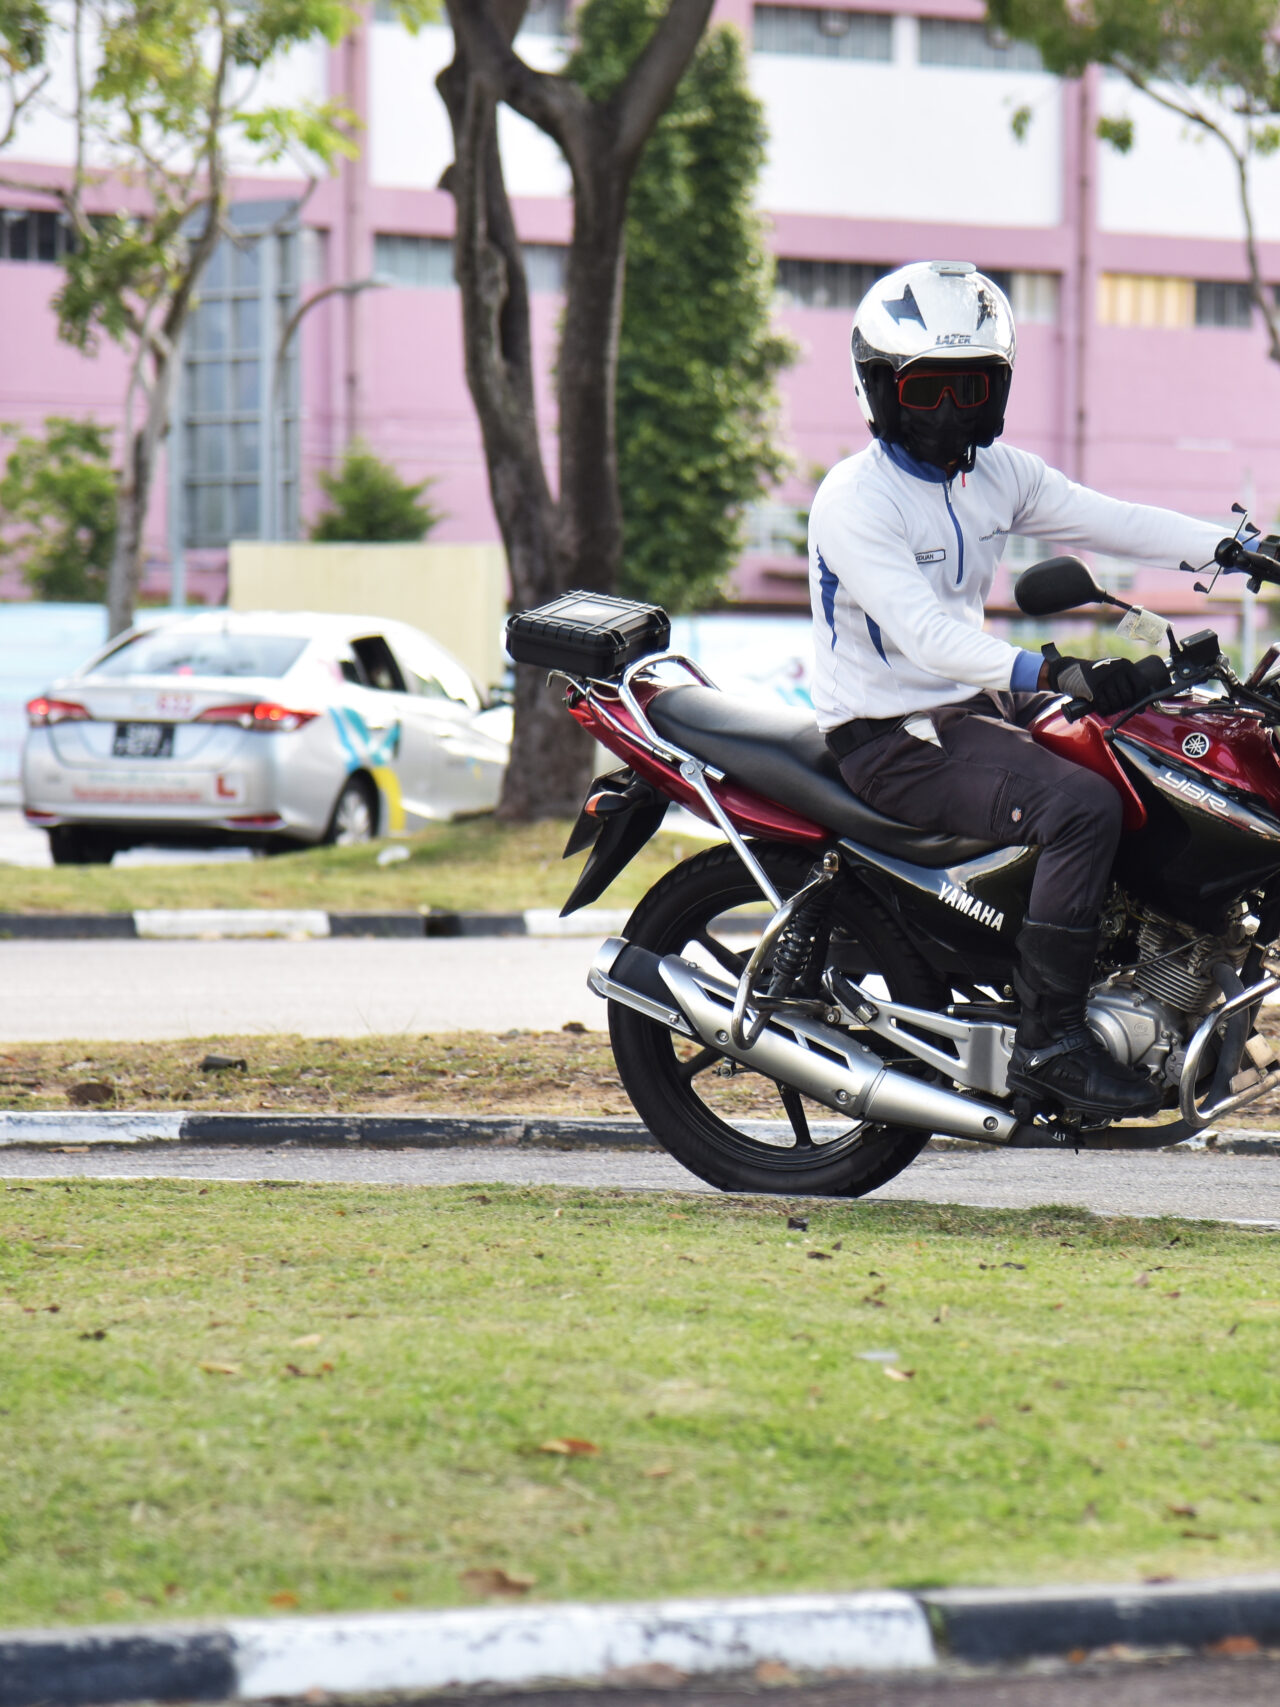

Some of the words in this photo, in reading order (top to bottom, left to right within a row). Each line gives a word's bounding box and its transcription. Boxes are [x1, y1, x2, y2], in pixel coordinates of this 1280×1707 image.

[935, 333, 972, 345] LAZER
[216, 774, 237, 797] L
[1157, 771, 1230, 817] YBR
[938, 881, 1005, 932] YAMAHA
